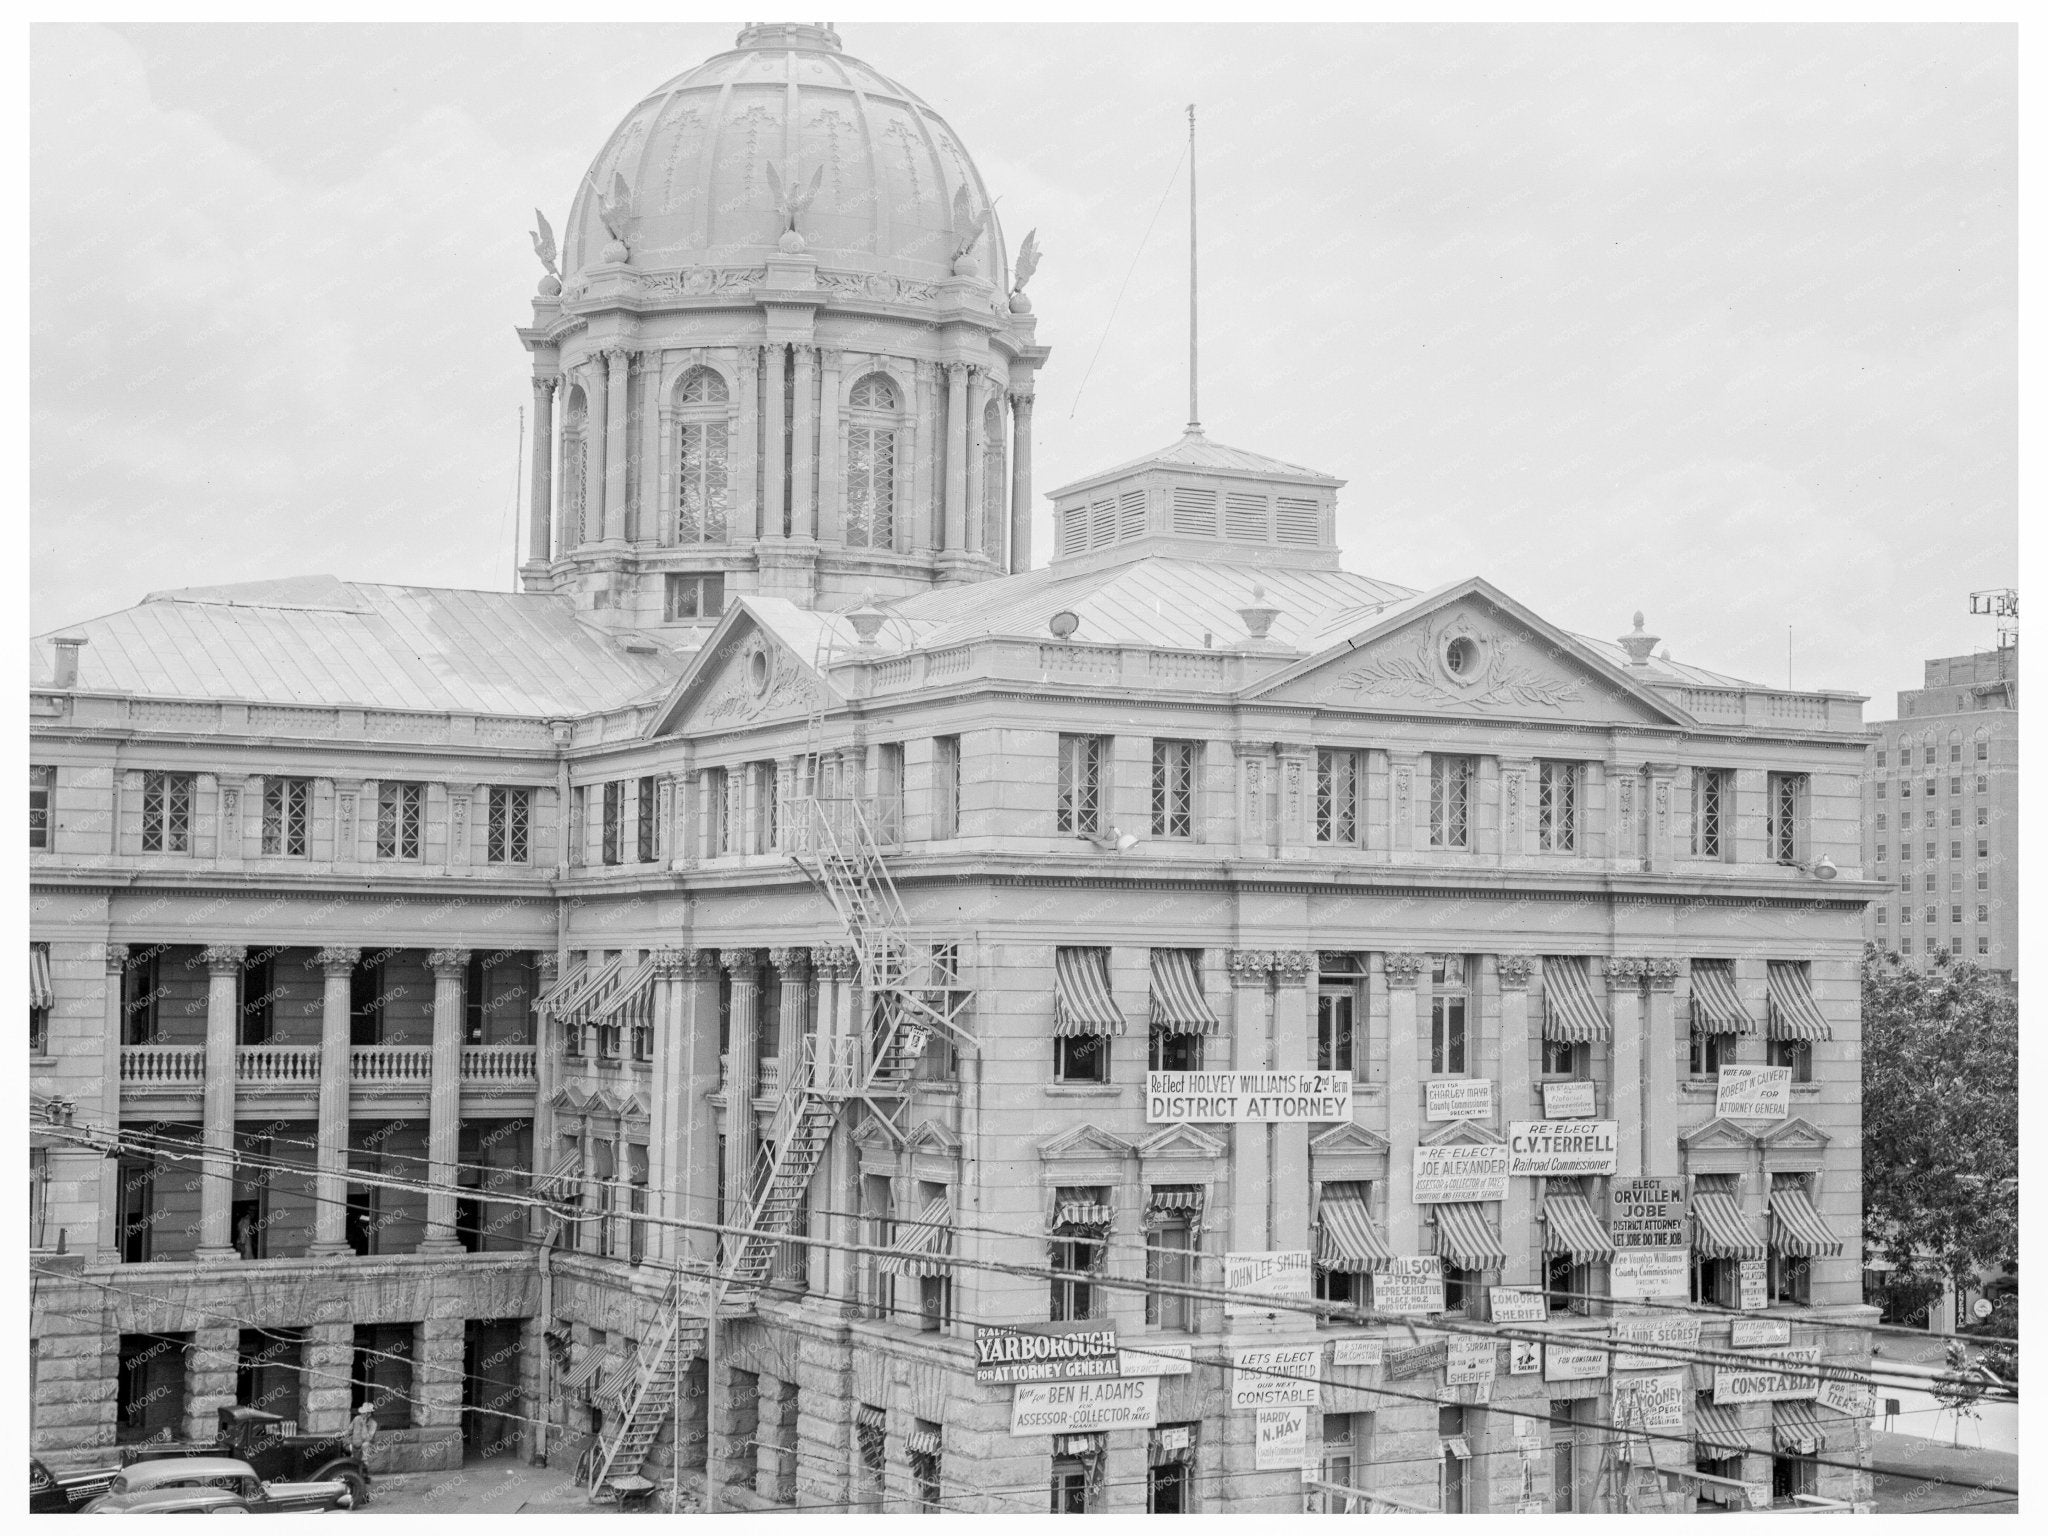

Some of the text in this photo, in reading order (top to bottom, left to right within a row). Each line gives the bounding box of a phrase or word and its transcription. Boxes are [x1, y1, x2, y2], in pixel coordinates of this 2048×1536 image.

[1723, 1068, 1752, 1077] VOTE FOR
[1189, 1075, 1236, 1093] HOLVEY
[1240, 1074, 1296, 1093] WILLIAMS
[1299, 1075, 1312, 1093] For
[1331, 1075, 1348, 1093] Term
[1720, 1080, 1748, 1098] ROBERT
[1756, 1069, 1789, 1086] CALVERT
[1430, 1087, 1488, 1100] CHARLEY MAYR
[1760, 1090, 1779, 1098] FOR
[1152, 1097, 1347, 1118] DISTRICT ATTORNEY
[1430, 1100, 1450, 1111] County
[1719, 1101, 1786, 1114] ATTORNEY GENERAL
[1529, 1124, 1599, 1134] RE-ELECT
[1429, 1147, 1498, 1158] RE-ELECT
[1418, 1159, 1506, 1176] JOE ALEXANDER
[1512, 1157, 1612, 1172] Railroad Commissioner
[1416, 1179, 1444, 1190] ASSESSOR
[1449, 1178, 1480, 1190] COLLECTOR
[1632, 1179, 1661, 1190] ELECT
[1480, 1190, 1504, 1198] SERVICE
[1614, 1190, 1683, 1204] ORVILLE M.
[1622, 1204, 1667, 1218] JOBE
[1613, 1219, 1681, 1231] DISTRICT ATTORNEY
[1613, 1232, 1682, 1247] LET JOBE DO THE JOB
[1653, 1252, 1682, 1264] Williams
[1228, 1253, 1308, 1289] JOHN LEE SMITH
[1615, 1266, 1637, 1278] County
[1395, 1275, 1417, 1285] FOR
[1376, 1285, 1442, 1297] REPRESENTATIVE
[1495, 1309, 1543, 1320] SHERIFF
[978, 1326, 1017, 1338] RALPH
[1734, 1323, 1747, 1331] TOM
[1619, 1327, 1700, 1342] CLAUDE SEGREST
[1735, 1335, 1788, 1343] DISTRICT JUDGE
[976, 1331, 1116, 1363] YARBOROUGH
[1466, 1341, 1496, 1352] SURRATT
[1241, 1352, 1314, 1365] LETS ELECT
[1571, 1355, 1602, 1364] CONSTABLE
[977, 1359, 1119, 1382] FOR ATTORNEY GENERAL
[1164, 1363, 1188, 1374] JUDGE
[1237, 1364, 1316, 1381] JESS STANFIELD
[1450, 1371, 1491, 1383] SHERIFF
[1731, 1374, 1816, 1394] CONSTABLE
[1830, 1384, 1845, 1393] FOR
[1049, 1386, 1075, 1403] BEN
[1079, 1385, 1093, 1402] H.
[1095, 1381, 1145, 1400] ADAMS
[1237, 1389, 1315, 1405] CONSTABLE
[1658, 1404, 1682, 1414] PEACE
[1131, 1411, 1150, 1421] TAXES
[1260, 1411, 1291, 1423] HARDY
